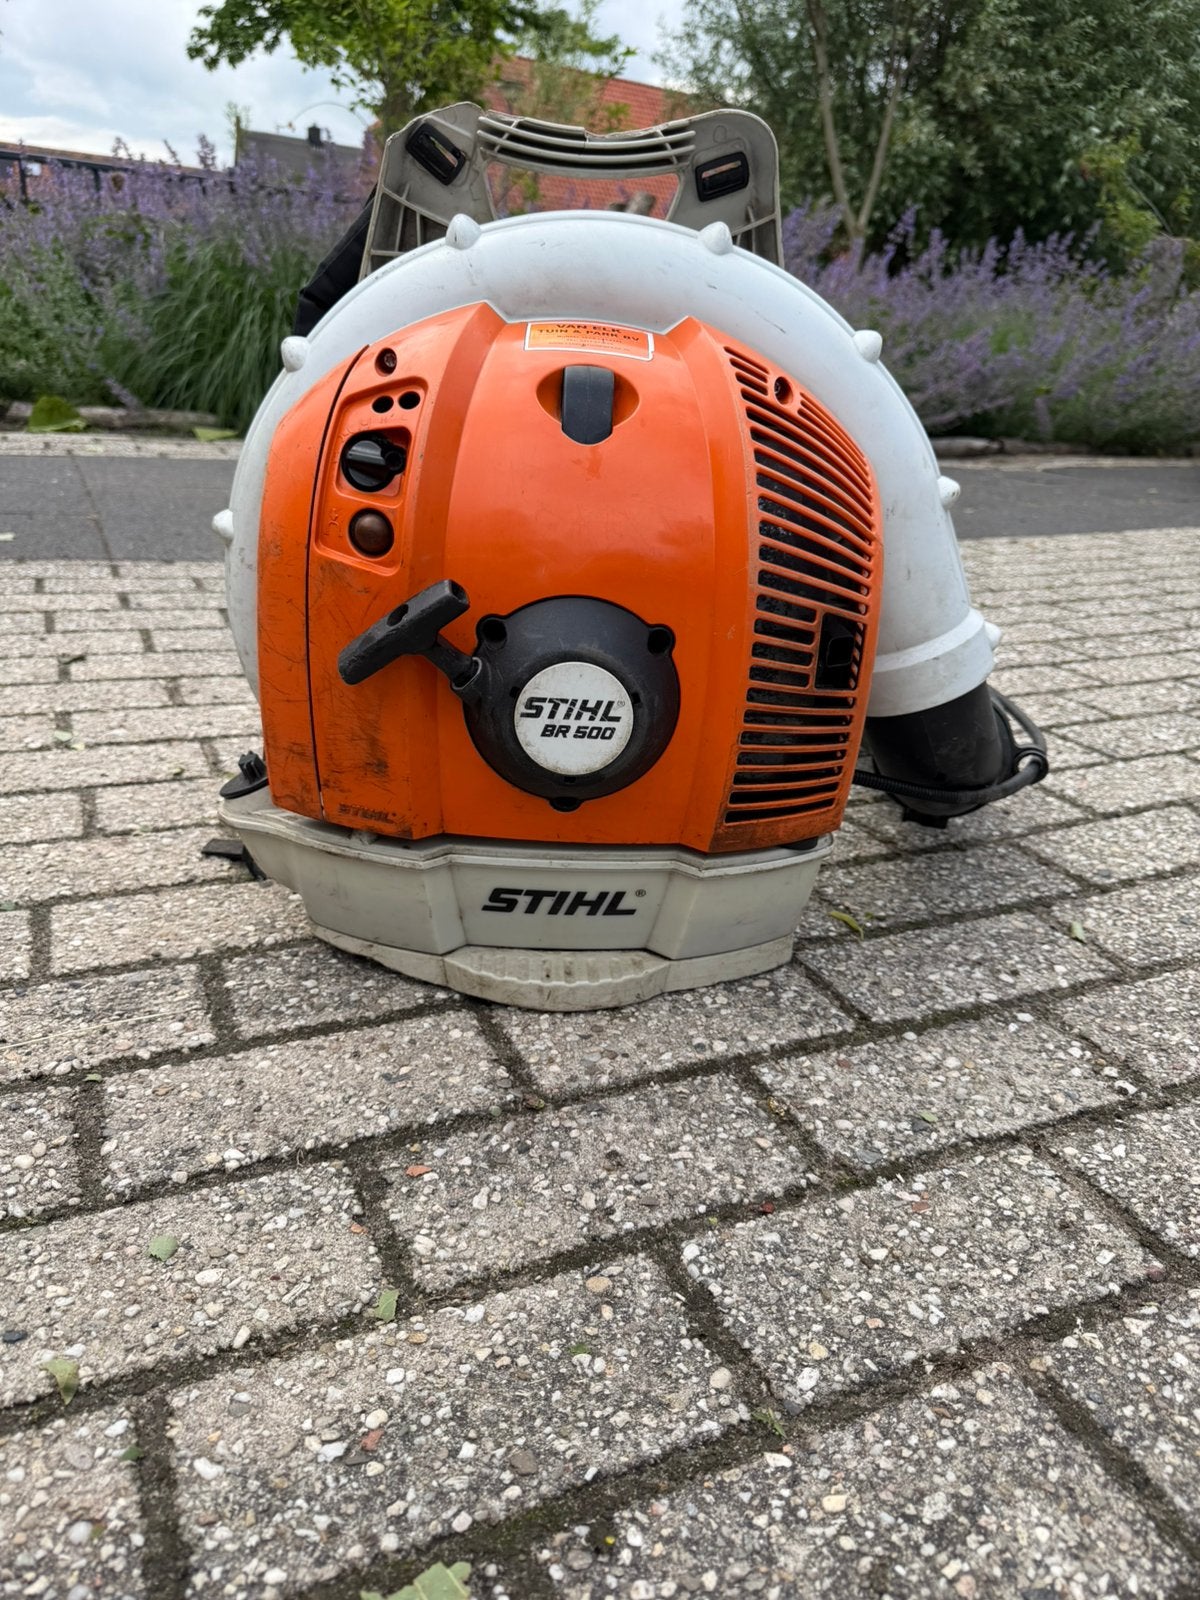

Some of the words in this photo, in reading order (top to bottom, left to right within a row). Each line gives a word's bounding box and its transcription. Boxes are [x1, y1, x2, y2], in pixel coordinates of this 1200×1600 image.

[586, 330, 618, 338] PARK
[540, 723, 571, 738] BR
[573, 725, 616, 740] 500
